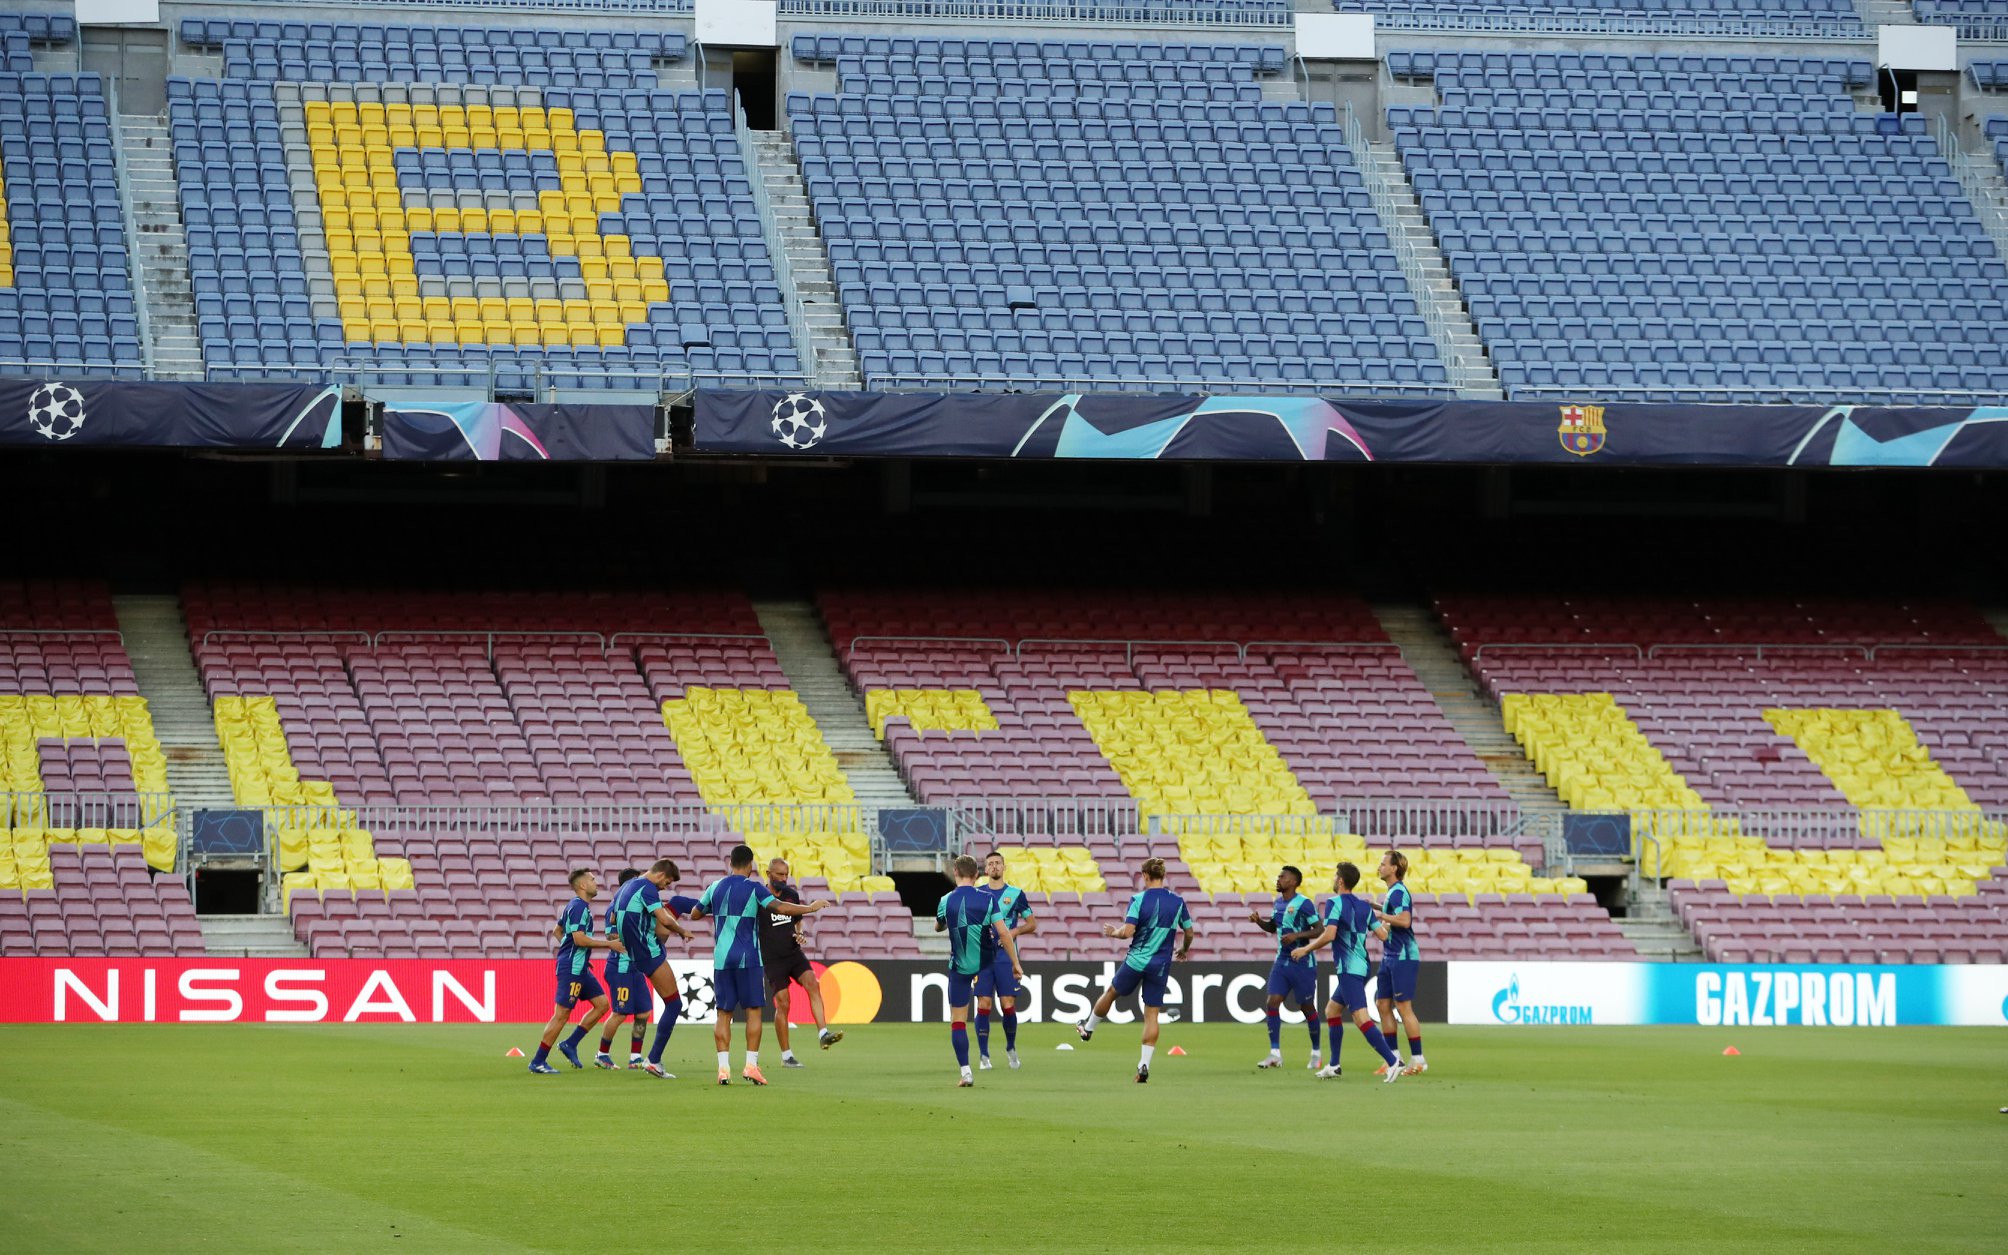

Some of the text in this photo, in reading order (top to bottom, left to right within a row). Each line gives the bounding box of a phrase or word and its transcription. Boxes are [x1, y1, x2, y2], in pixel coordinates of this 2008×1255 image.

[53, 968, 496, 1022] NISSAN
[569, 981, 582, 998] 18
[616, 986, 630, 1002] 10
[910, 961, 1410, 1024] masterc
[1695, 971, 1897, 1027] GAZPROM
[1522, 1005, 1593, 1025] GAZPROM
